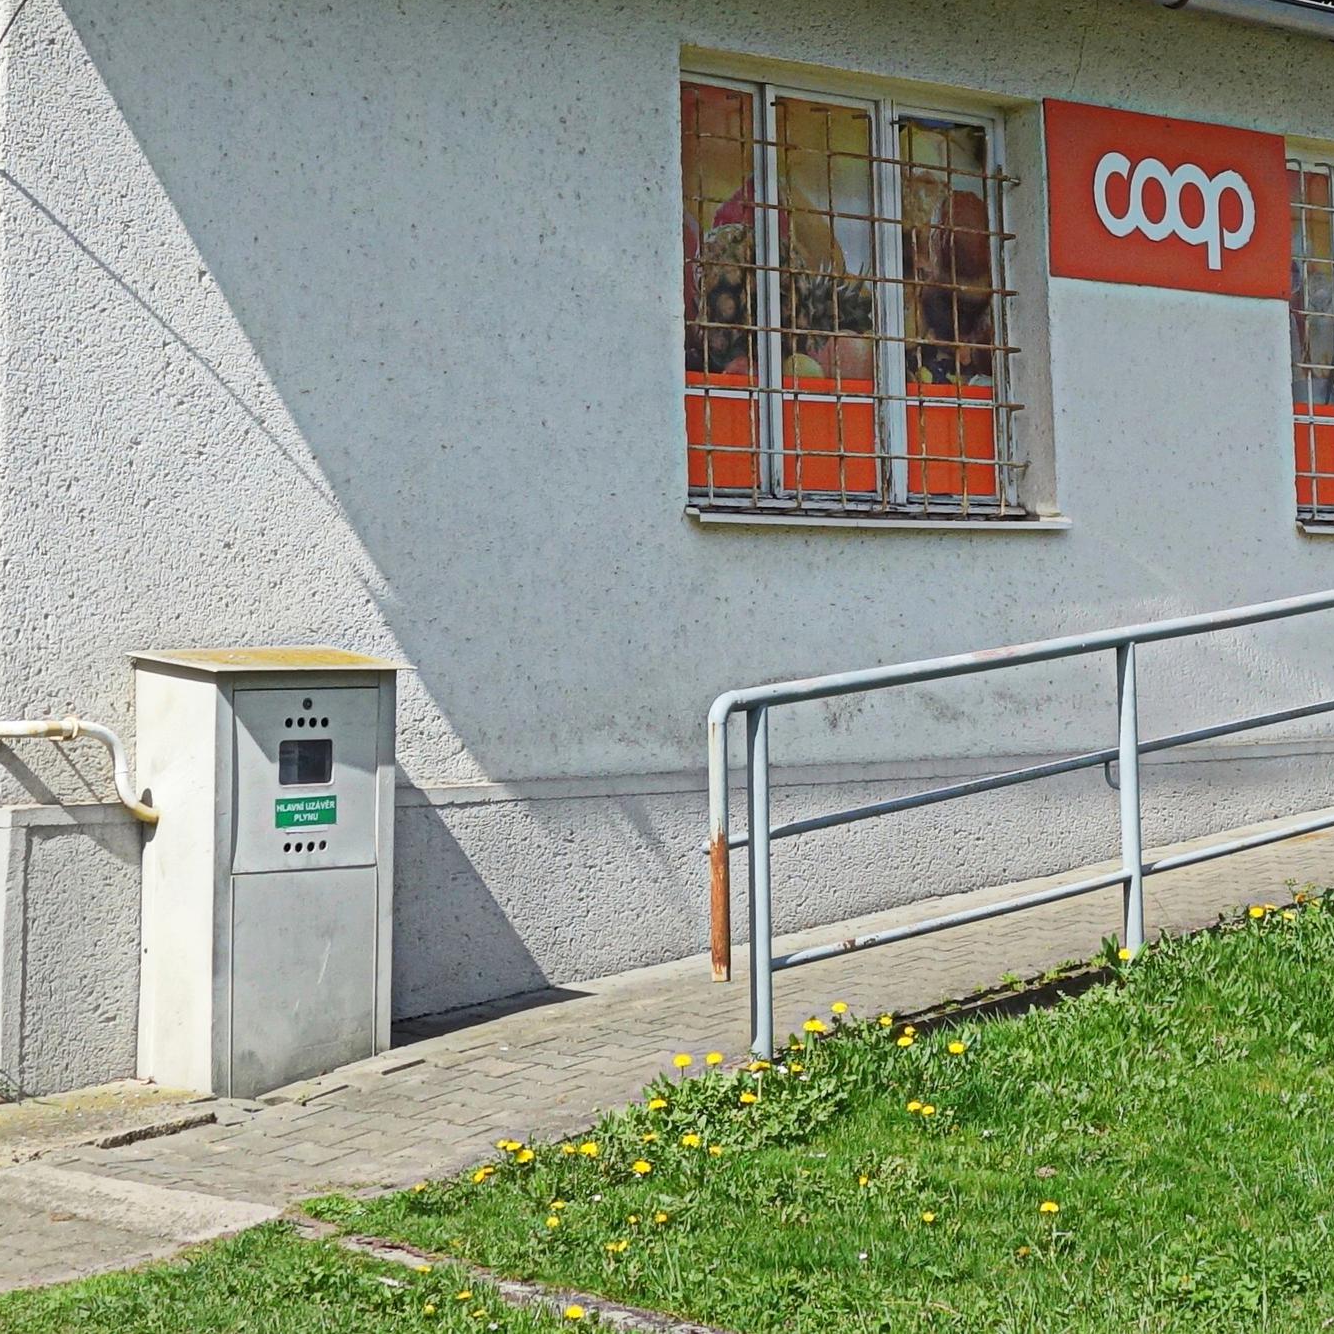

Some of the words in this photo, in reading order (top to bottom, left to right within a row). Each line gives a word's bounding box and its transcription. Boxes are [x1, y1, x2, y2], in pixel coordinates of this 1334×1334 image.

[1093, 151, 1256, 271] coop
[276, 802, 304, 813] HLAVNÍ
[293, 813, 319, 822] PLYNU
